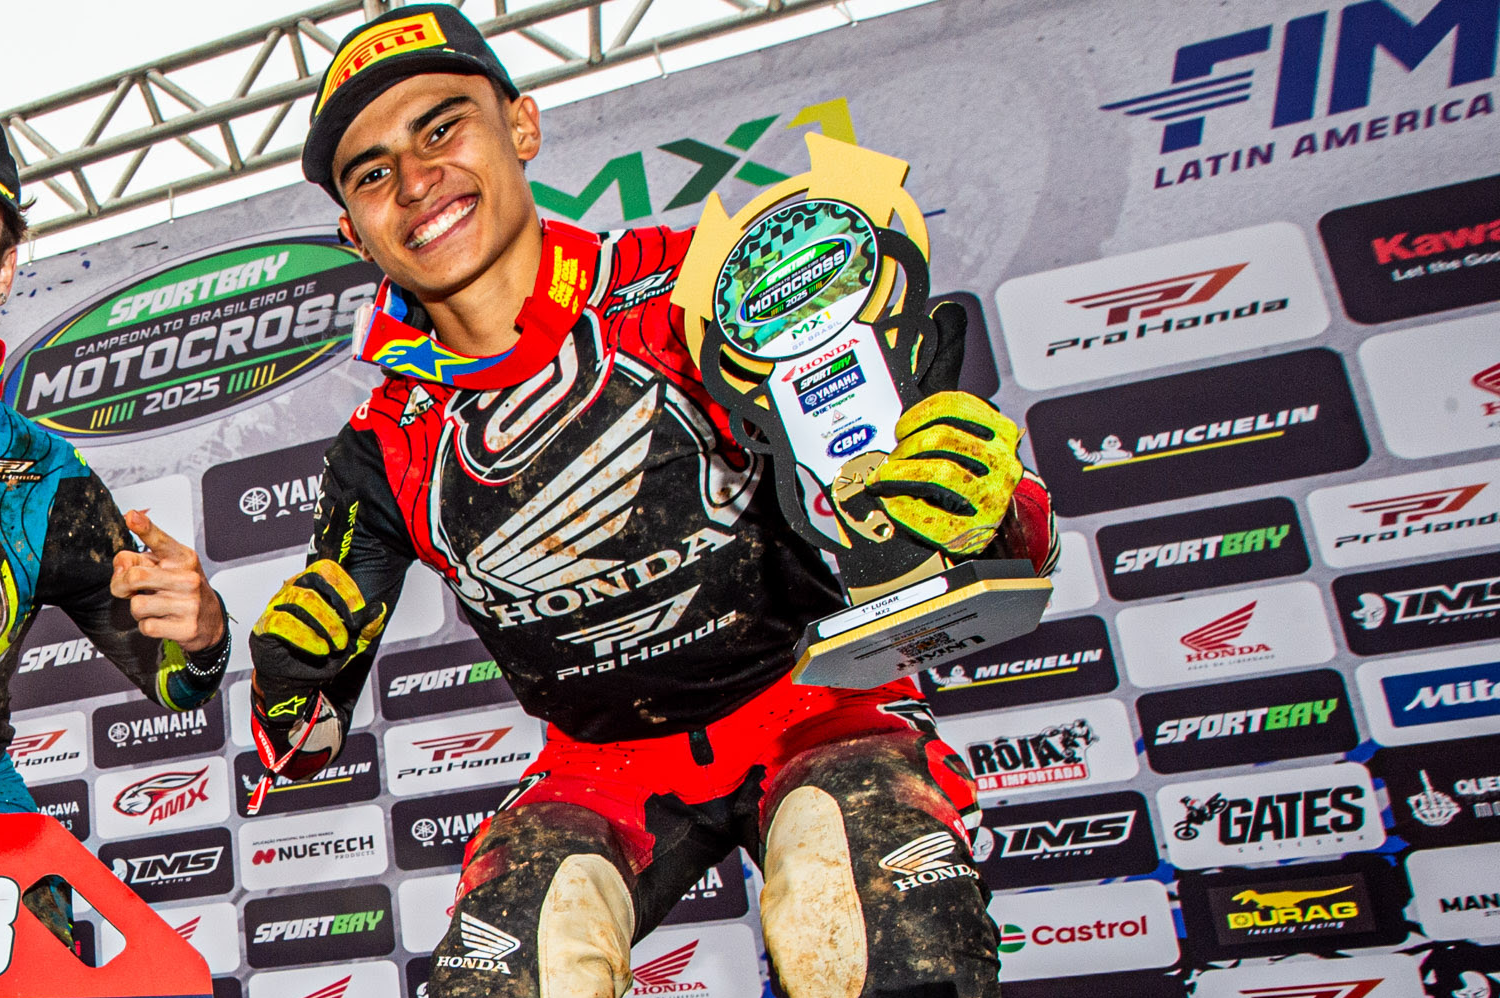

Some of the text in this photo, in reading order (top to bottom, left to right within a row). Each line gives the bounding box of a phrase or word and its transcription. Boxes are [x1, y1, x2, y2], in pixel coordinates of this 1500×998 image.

[1155, 0, 1499, 155] FIM
[1153, 92, 1495, 190] LATIN AMERICA
[106, 251, 290, 328] SPORTBAY
[749, 249, 846, 319] MOTOCROSS
[785, 289, 808, 308] 2025
[75, 280, 318, 359] CAMPEONATO BRASILEIRO DE
[791, 311, 832, 341] MX1
[26, 281, 378, 412] MOTOCROSS
[798, 338, 861, 375] HONDA
[800, 355, 852, 391] SPORTBAY
[816, 372, 860, 398] YAMAHA
[142, 375, 222, 417] 2025
[833, 428, 868, 454] CBM
[1135, 404, 1320, 453] MICHELIN
[1113, 523, 1291, 576] SPORTBAY
[488, 526, 737, 628] HONDA
[870, 595, 900, 612] LUGAR
[874, 607, 892, 617] MX2
[18, 636, 105, 674] SPOR
[974, 648, 1103, 680] MICHELIN
[1185, 643, 1272, 663] HONDA
[387, 660, 503, 698] SPORTBA
[130, 709, 208, 738] YAMAHA
[1153, 697, 1339, 746] SPORTBAY
[116, 728, 203, 748] RACING
[1001, 765, 1084, 788] IMPORTADA
[37, 801, 80, 816] ACAVA
[148, 778, 210, 826] AMX
[1218, 784, 1366, 846] GATES
[437, 810, 496, 837] YAM
[994, 810, 1136, 858] IMS
[278, 835, 375, 862] NUETECH
[335, 850, 376, 860] PRODUCTS
[1032, 848, 1094, 860] racing
[130, 847, 225, 884] IMS
[151, 876, 192, 886] racing
[892, 864, 980, 892] HONDA
[253, 909, 385, 944] SPORTBAY
[1031, 915, 1148, 946] Castrol
[1226, 902, 1359, 930] DURAG
[1248, 920, 1346, 936] factory racing
[436, 954, 514, 976] HONDA
[633, 981, 708, 997] HONDA
